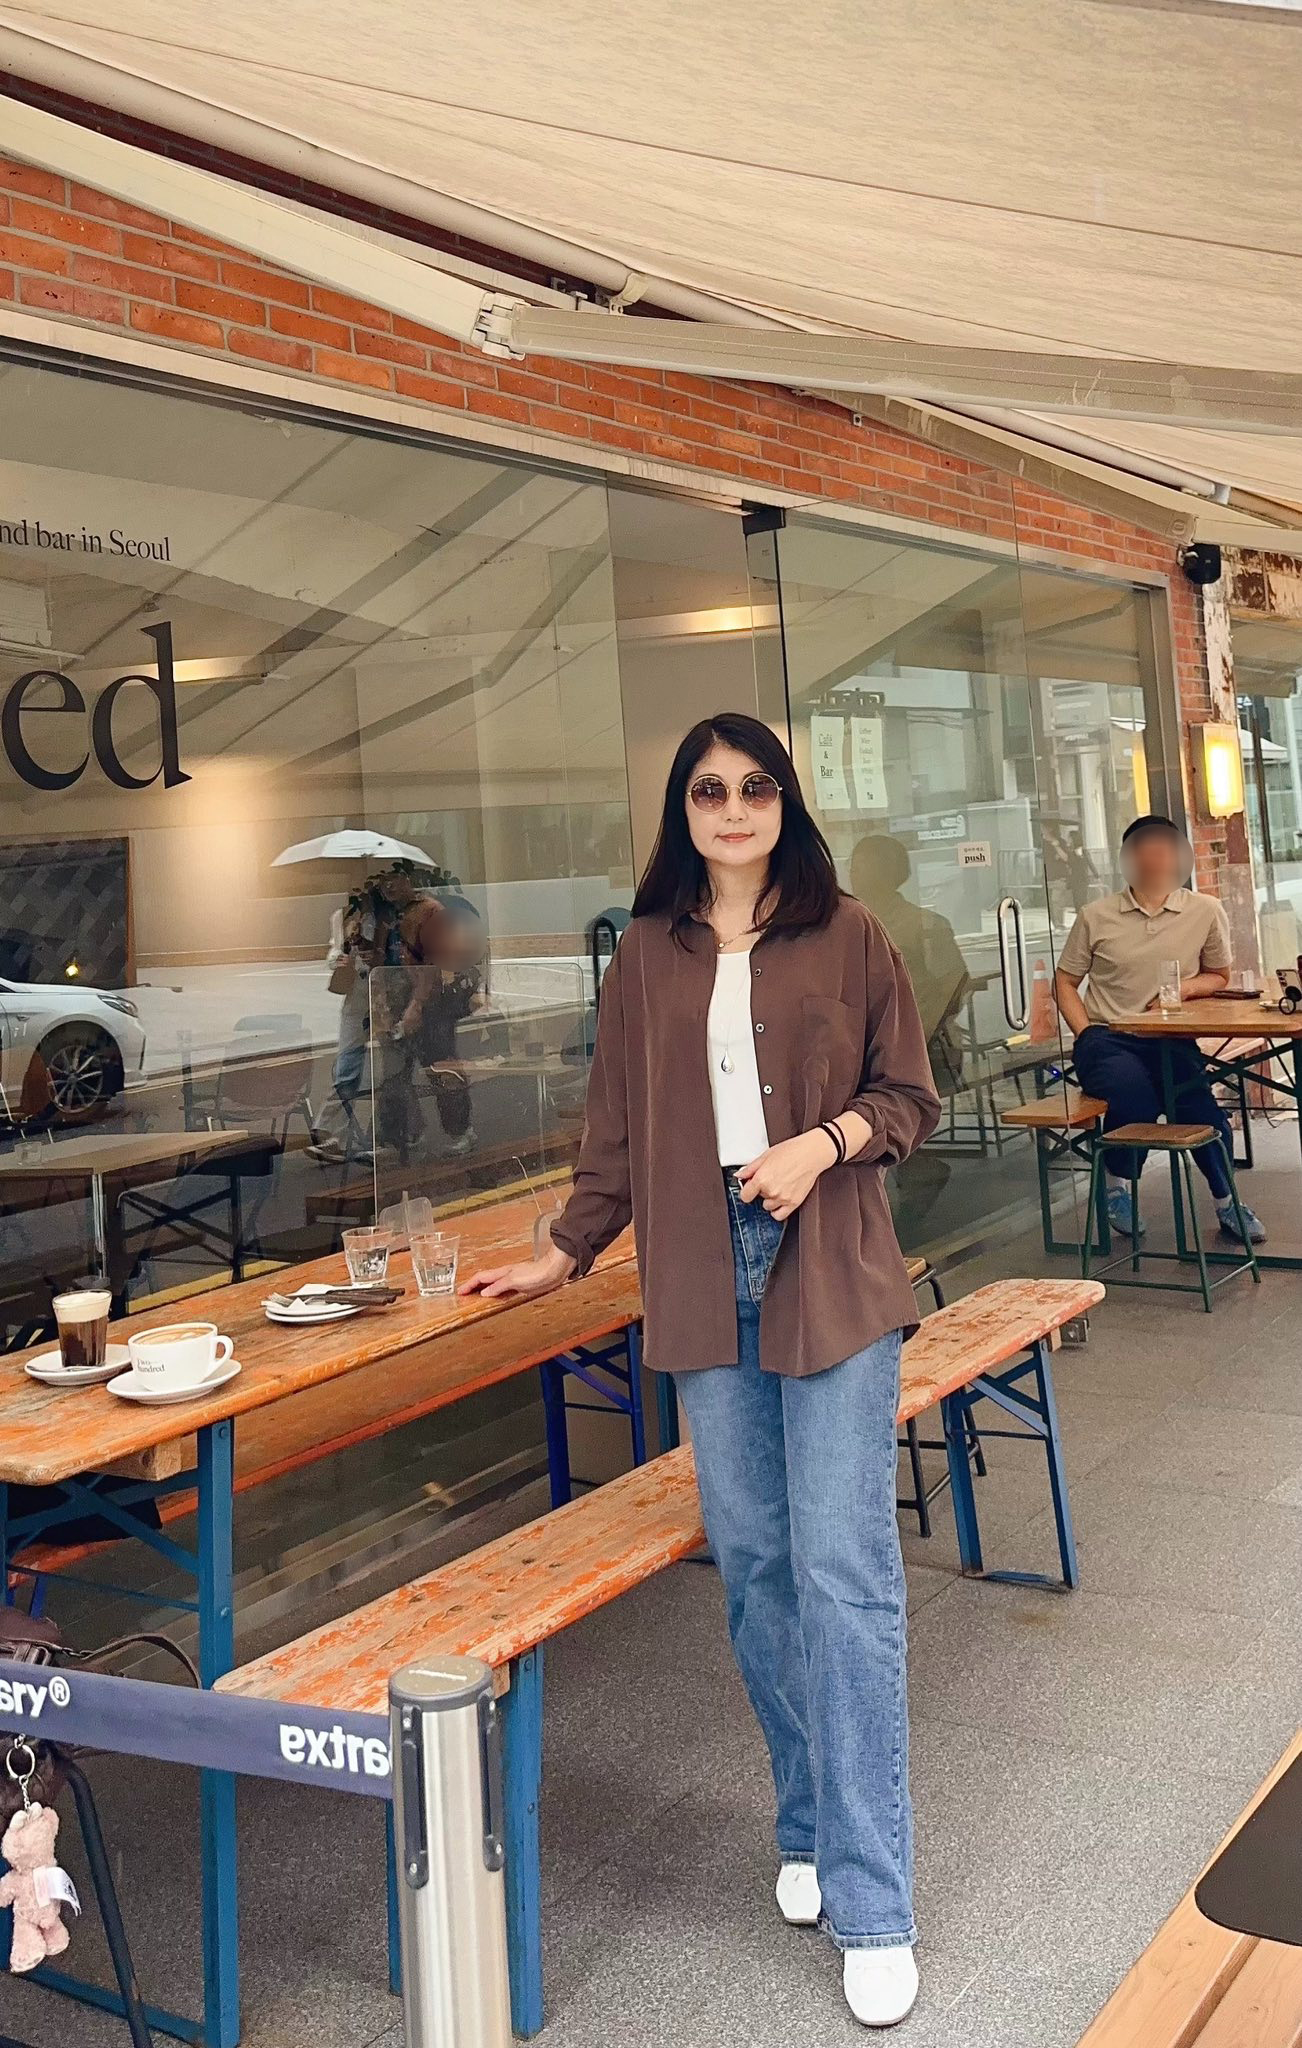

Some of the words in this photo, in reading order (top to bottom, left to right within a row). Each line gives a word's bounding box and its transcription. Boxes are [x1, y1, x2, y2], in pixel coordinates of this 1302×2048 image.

[0, 519, 29, 546] nd
[35, 521, 75, 551] bar
[81, 526, 103, 554] in
[109, 529, 171, 561] Seoul
[1, 621, 192, 790] ed
[820, 765, 833, 777] Bar
[964, 852, 986, 864] push
